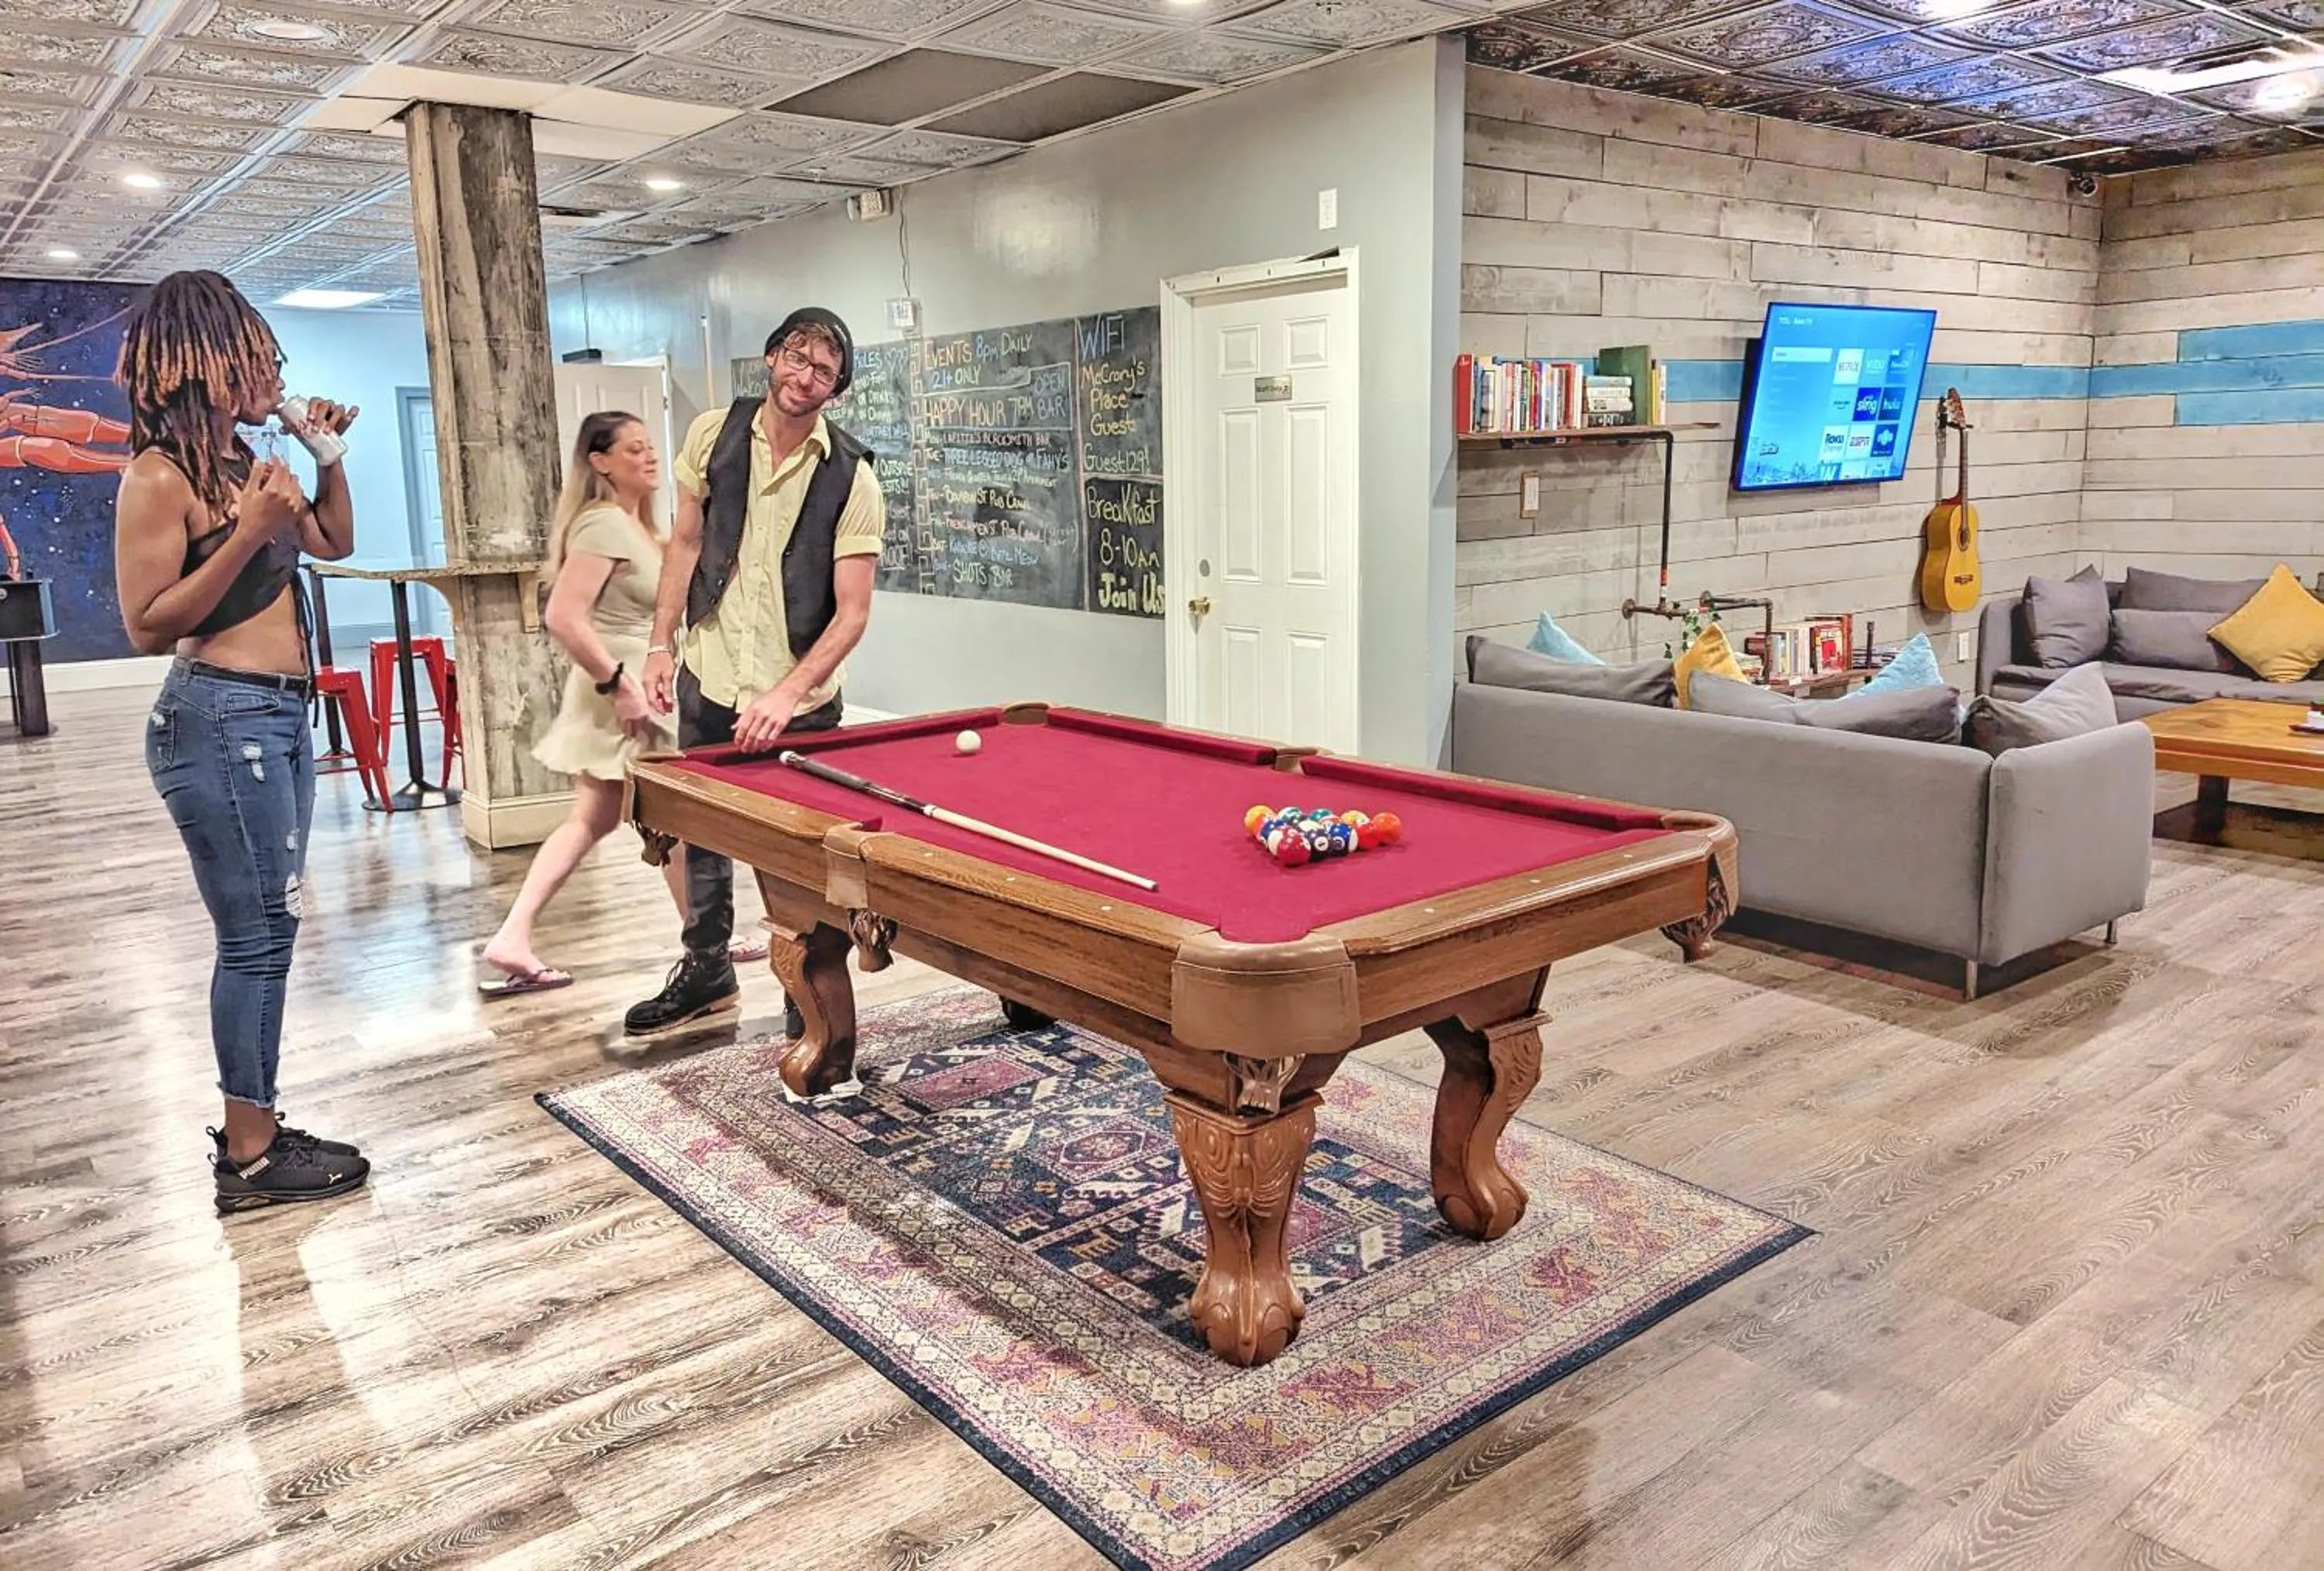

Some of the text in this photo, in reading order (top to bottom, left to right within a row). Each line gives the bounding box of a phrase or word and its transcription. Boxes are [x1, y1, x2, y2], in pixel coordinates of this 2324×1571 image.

[1077, 314, 1125, 360] WIFI
[924, 339, 973, 373] EVENTS
[954, 364, 982, 385] ONLY
[923, 396, 967, 429] HAPPY
[970, 398, 1007, 427] HOUR
[1037, 394, 1067, 420] BAR
[1090, 388, 1129, 413] Place
[1098, 572, 1137, 611] Join
